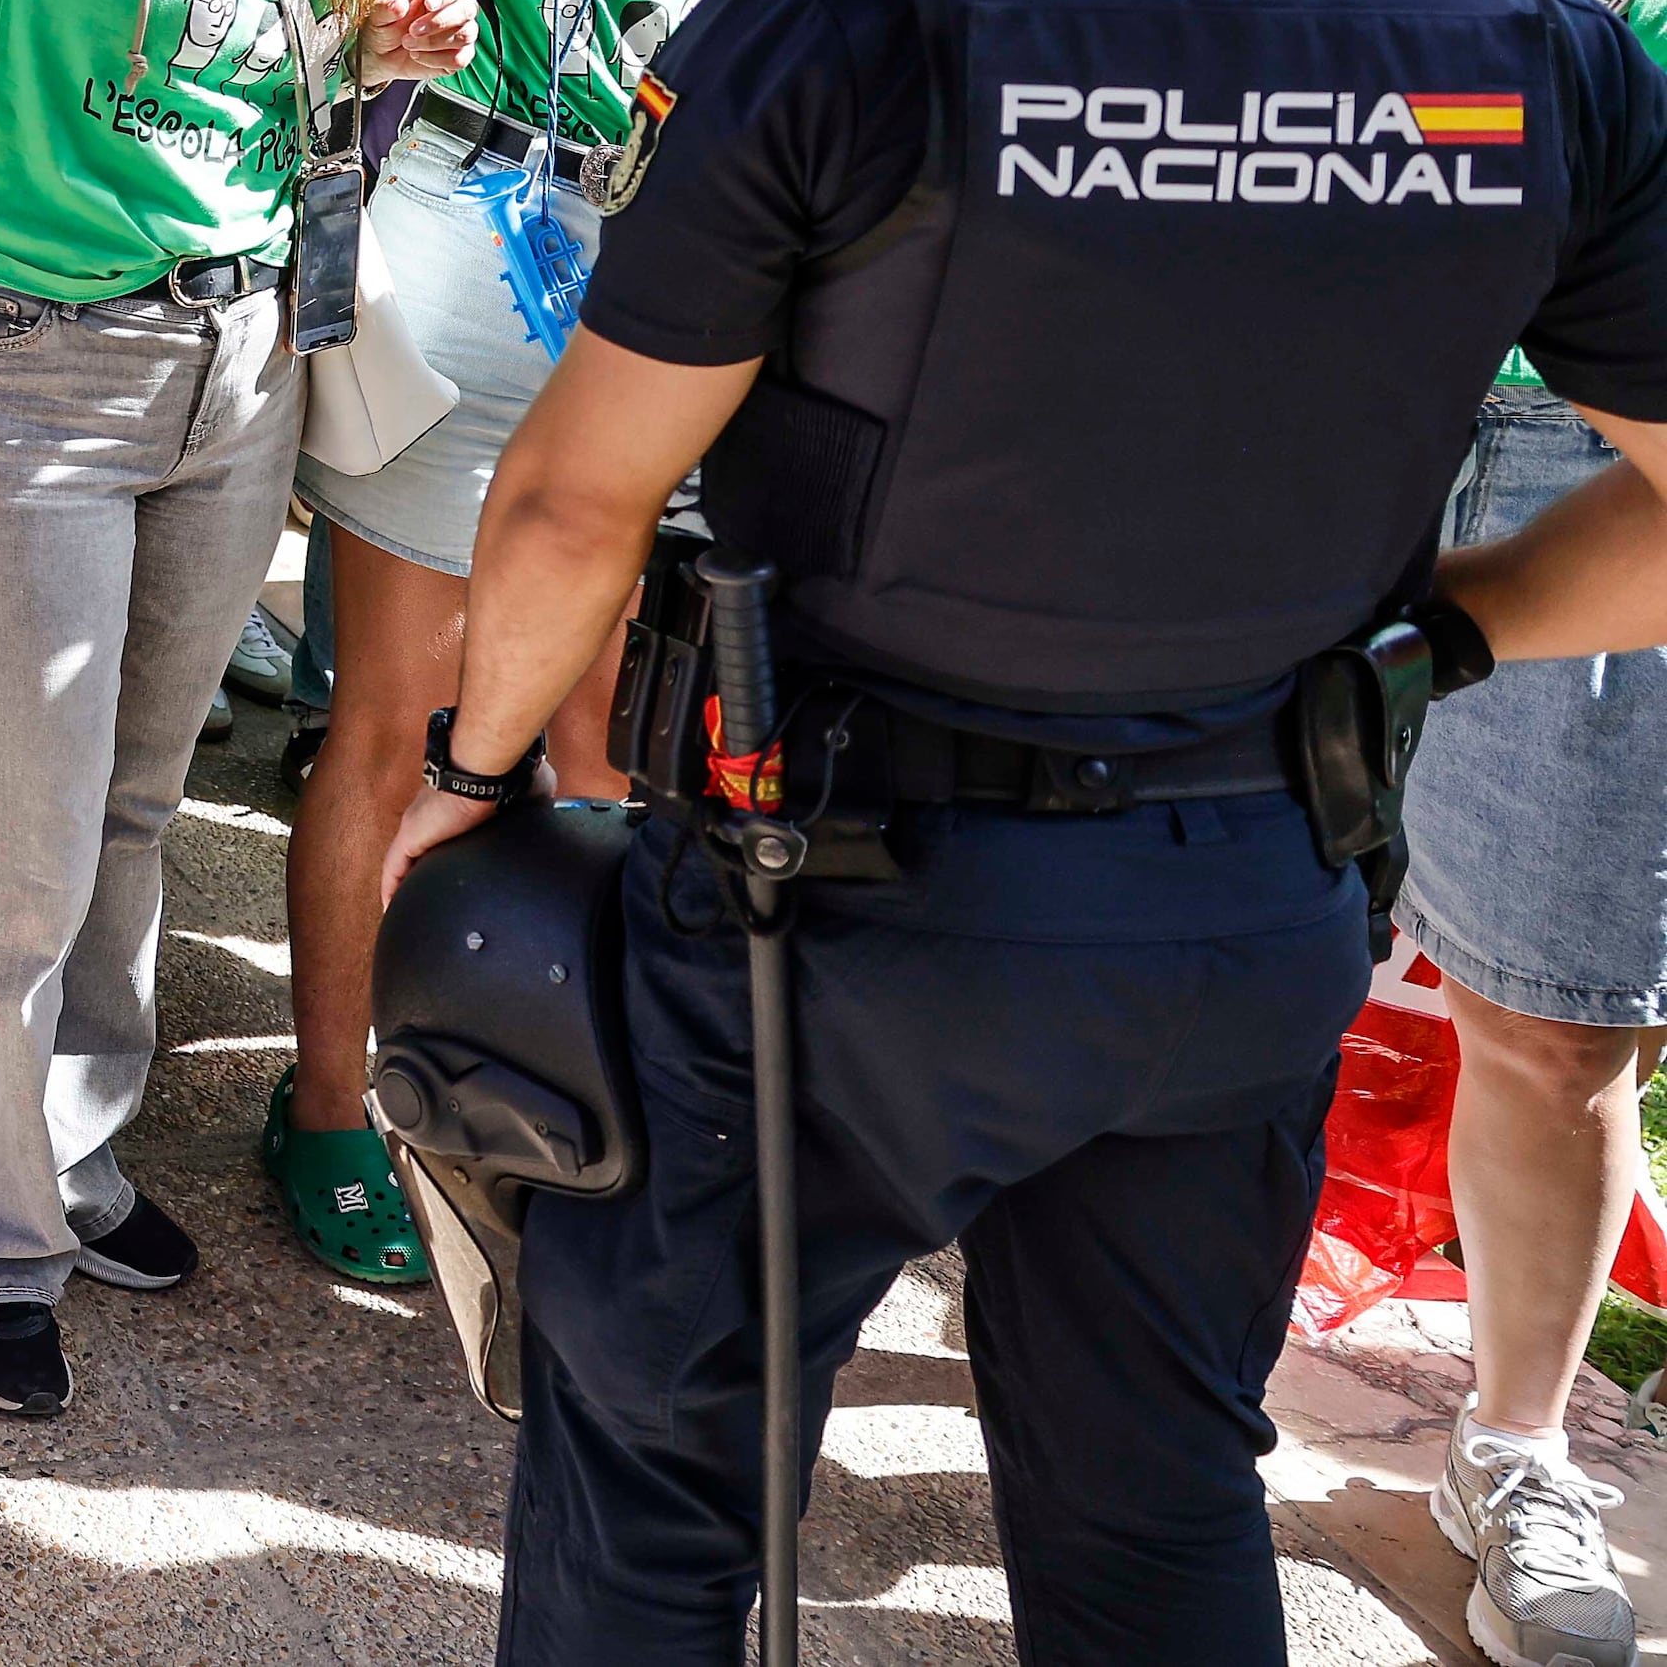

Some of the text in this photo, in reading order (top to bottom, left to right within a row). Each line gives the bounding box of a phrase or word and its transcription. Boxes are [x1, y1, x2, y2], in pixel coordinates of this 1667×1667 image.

[82, 78, 248, 163] L'ESCOLA
[998, 139, 1522, 204] NACIONAL
[333, 1181, 369, 1213] M
